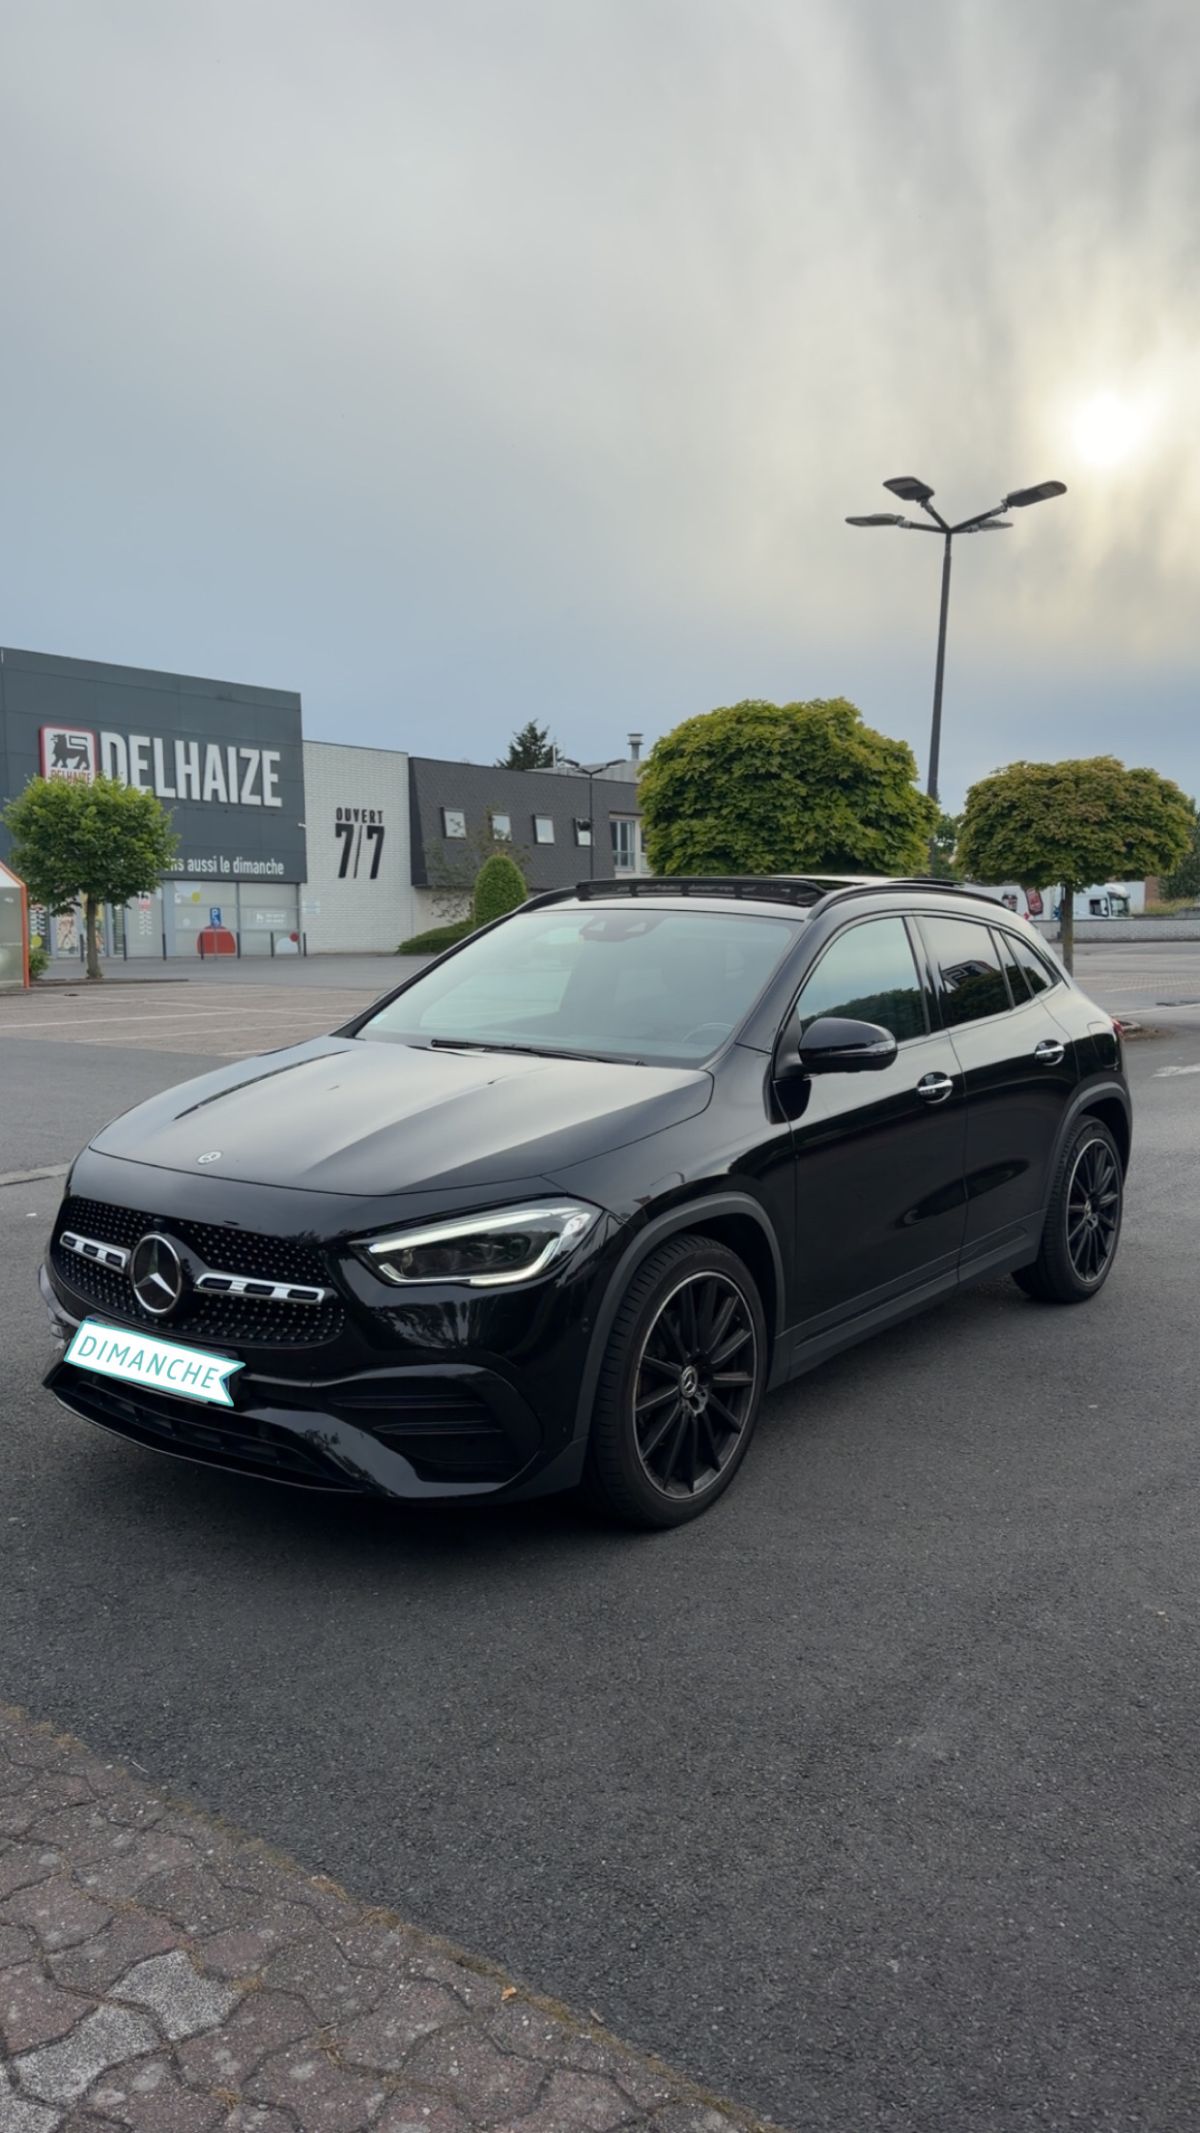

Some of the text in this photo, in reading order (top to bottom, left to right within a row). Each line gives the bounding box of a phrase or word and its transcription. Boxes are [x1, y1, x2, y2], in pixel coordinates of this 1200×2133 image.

[100, 731, 282, 807] DELHAIZE
[336, 807, 383, 824] OUVERT
[187, 856, 217, 873] aussi
[220, 856, 231, 873] le
[233, 857, 284, 875] dimanche
[335, 823, 385, 880] 7/7
